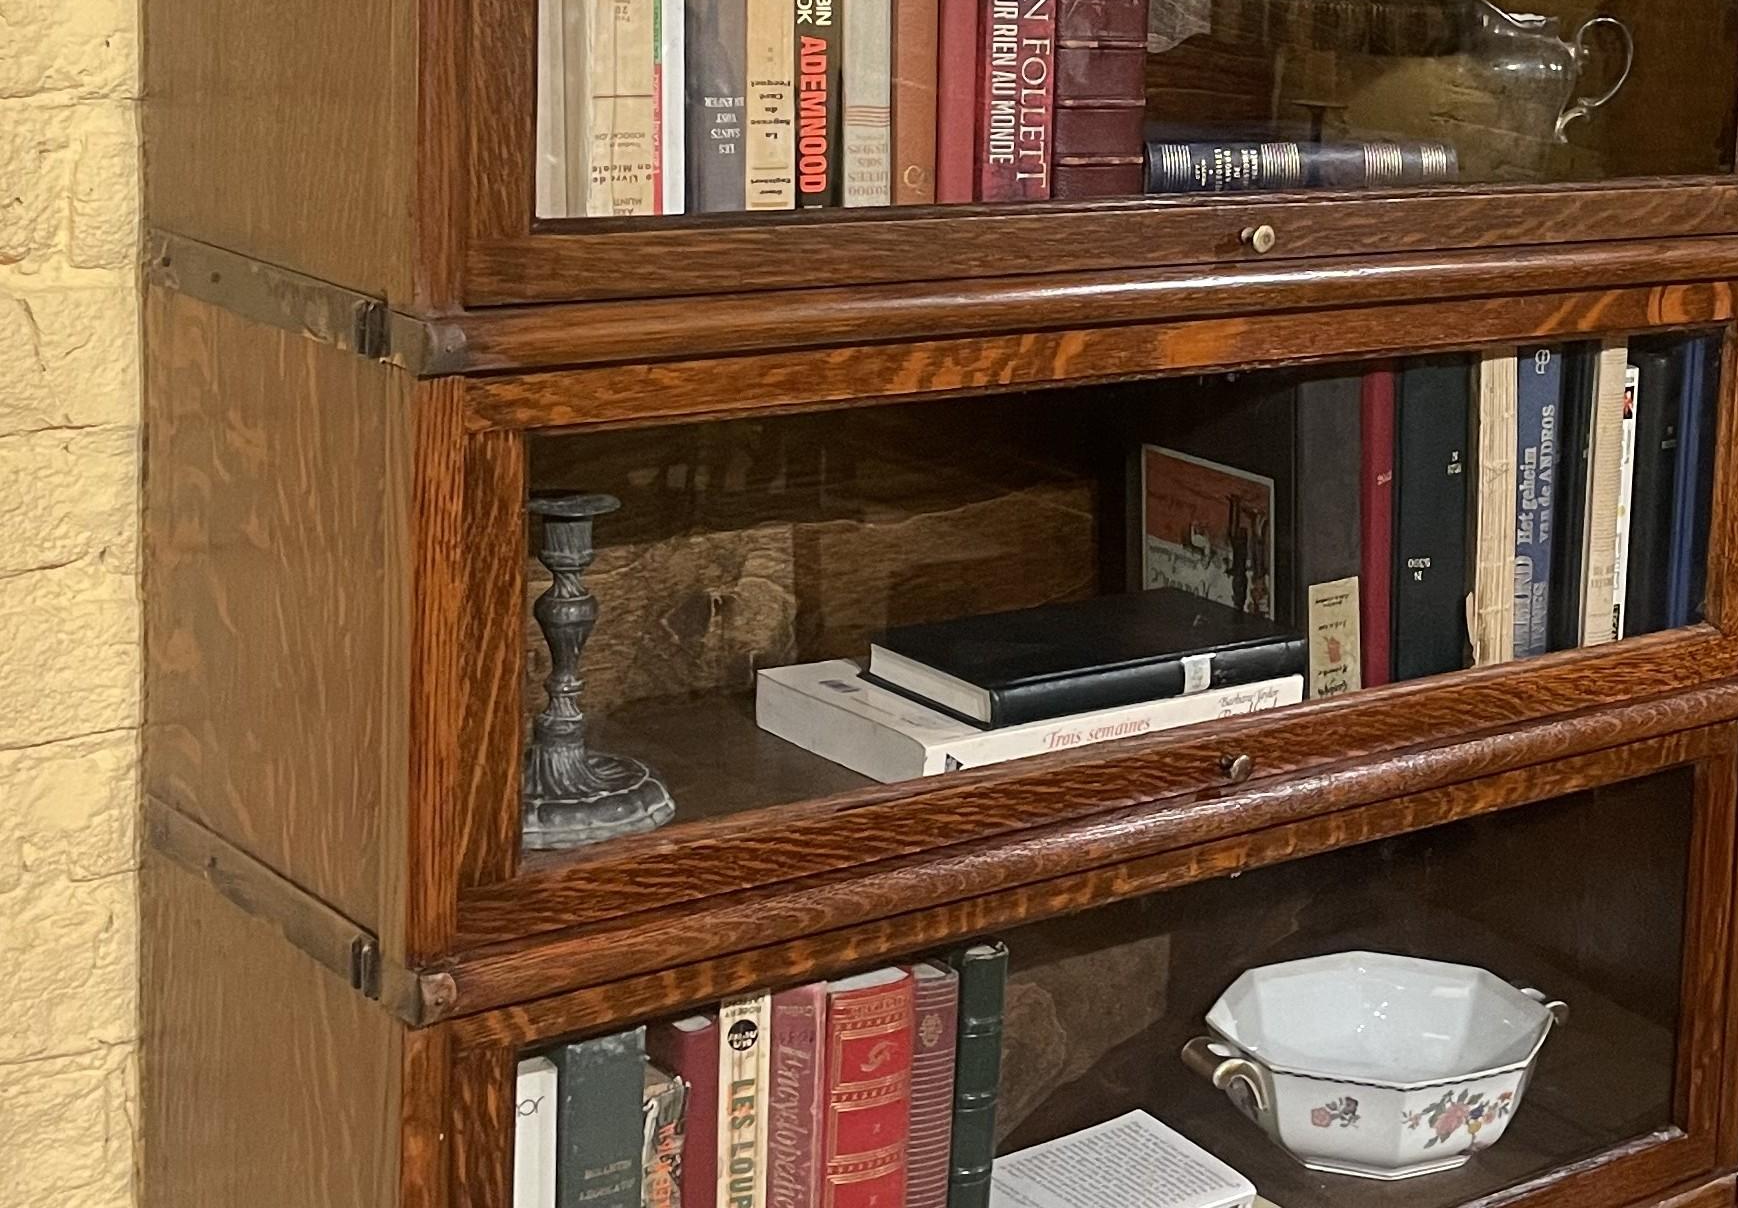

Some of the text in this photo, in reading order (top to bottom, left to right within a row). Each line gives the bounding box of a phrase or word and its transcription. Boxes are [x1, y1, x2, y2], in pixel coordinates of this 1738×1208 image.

[992, 24, 1018, 70] RIEN
[991, 72, 1016, 98] AU
[710, 128, 740, 139] SAINTS
[798, 35, 828, 194] ADEMNOOD
[988, 100, 1016, 165] MONDE
[1016, 37, 1051, 189] FOLLETT
[718, 144, 735, 154] LES
[1516, 446, 1538, 545] Het geheim
[1537, 404, 1556, 543] van de ANDROS
[1042, 717, 1152, 751] Trois semaines
[728, 1079, 756, 1130] LES
